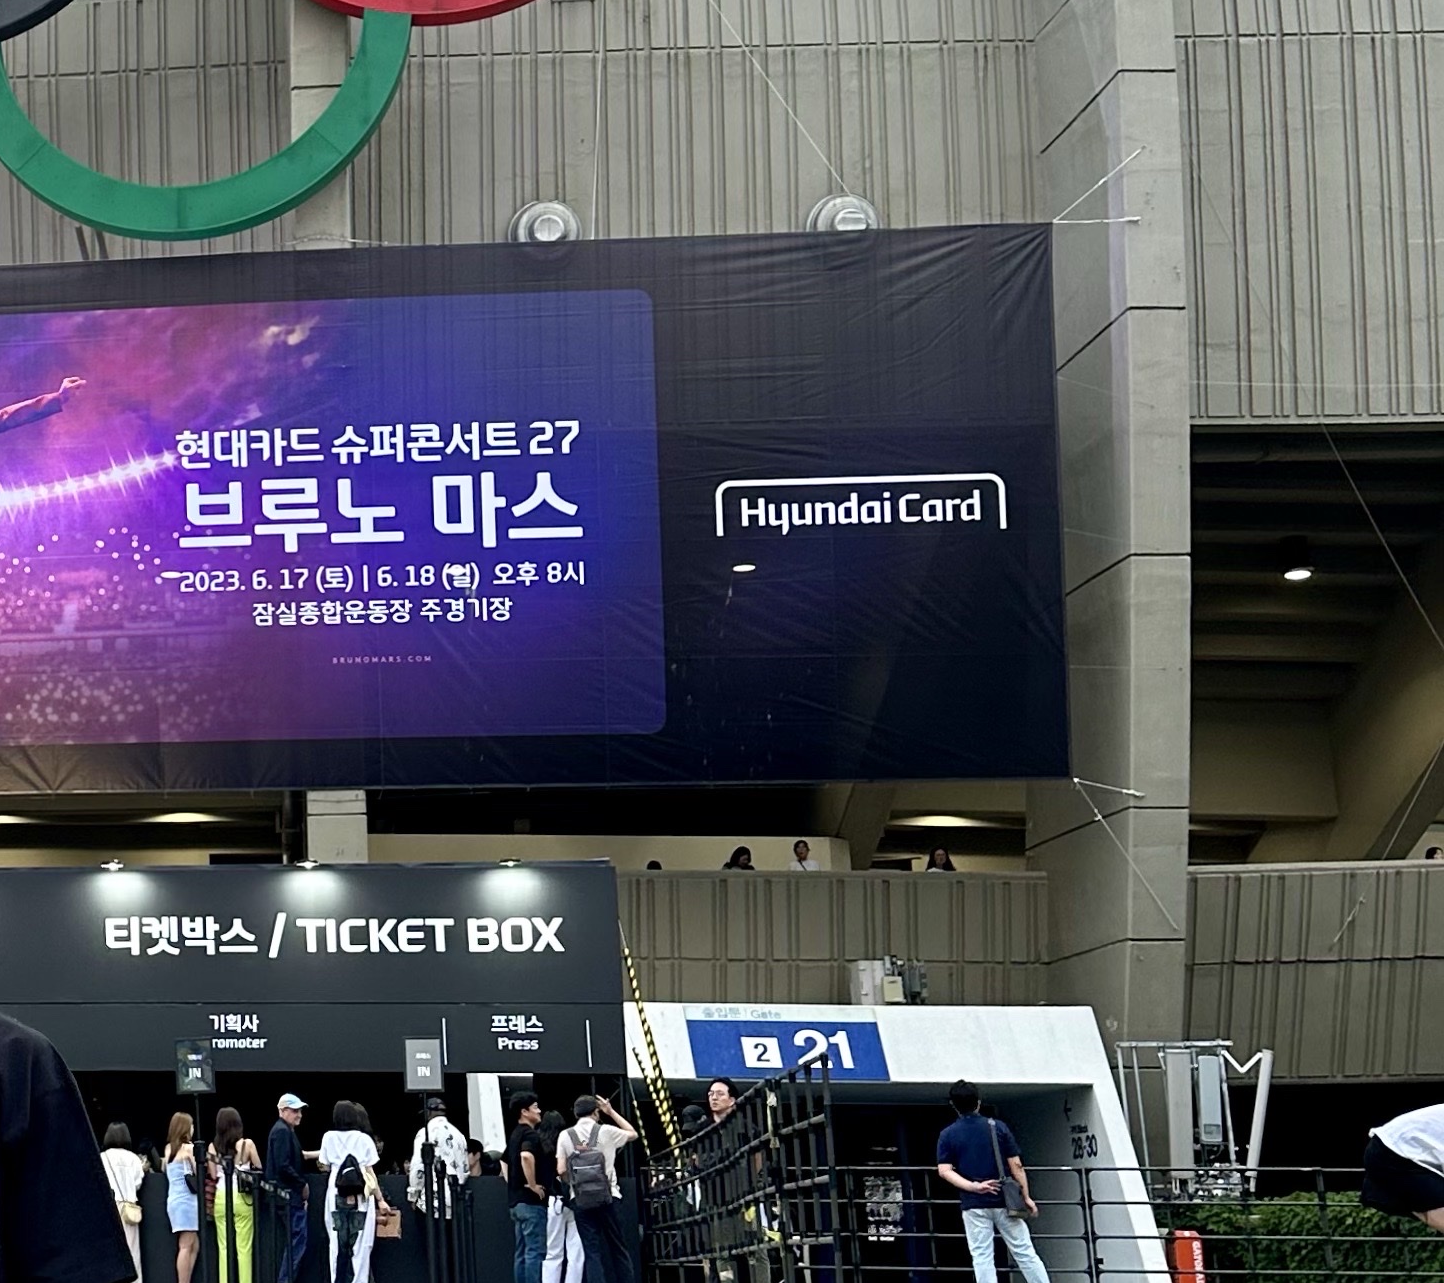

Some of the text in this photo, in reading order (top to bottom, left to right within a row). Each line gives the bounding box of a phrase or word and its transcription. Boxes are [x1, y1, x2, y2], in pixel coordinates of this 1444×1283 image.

[175, 420, 581, 470] 현대카드 슈퍼콘서트 27
[178, 471, 584, 554] 브루노 마스
[740, 488, 982, 536] Hyundai Card
[179, 568, 247, 593] 2023.
[252, 568, 273, 591] 6.
[280, 567, 309, 590] 17
[315, 565, 354, 593] (토)
[376, 565, 399, 587] 6.
[404, 564, 436, 587] 18
[492, 562, 539, 587] 오후
[546, 560, 586, 586] 8시
[252, 596, 513, 627] 잠실종합운동장 주경기장
[332, 655, 432, 665] BRUNOMARS.COM
[104, 915, 258, 956] 티켓박스
[295, 917, 455, 953] TICKET
[466, 916, 566, 953] BOX
[208, 1013, 260, 1033] 기획사
[490, 1015, 545, 1034] 프레스
[212, 1037, 268, 1049] romoter
[497, 1036, 540, 1051] Press
[753, 1028, 855, 1069] 2 21
[417, 1066, 431, 1077] IN
